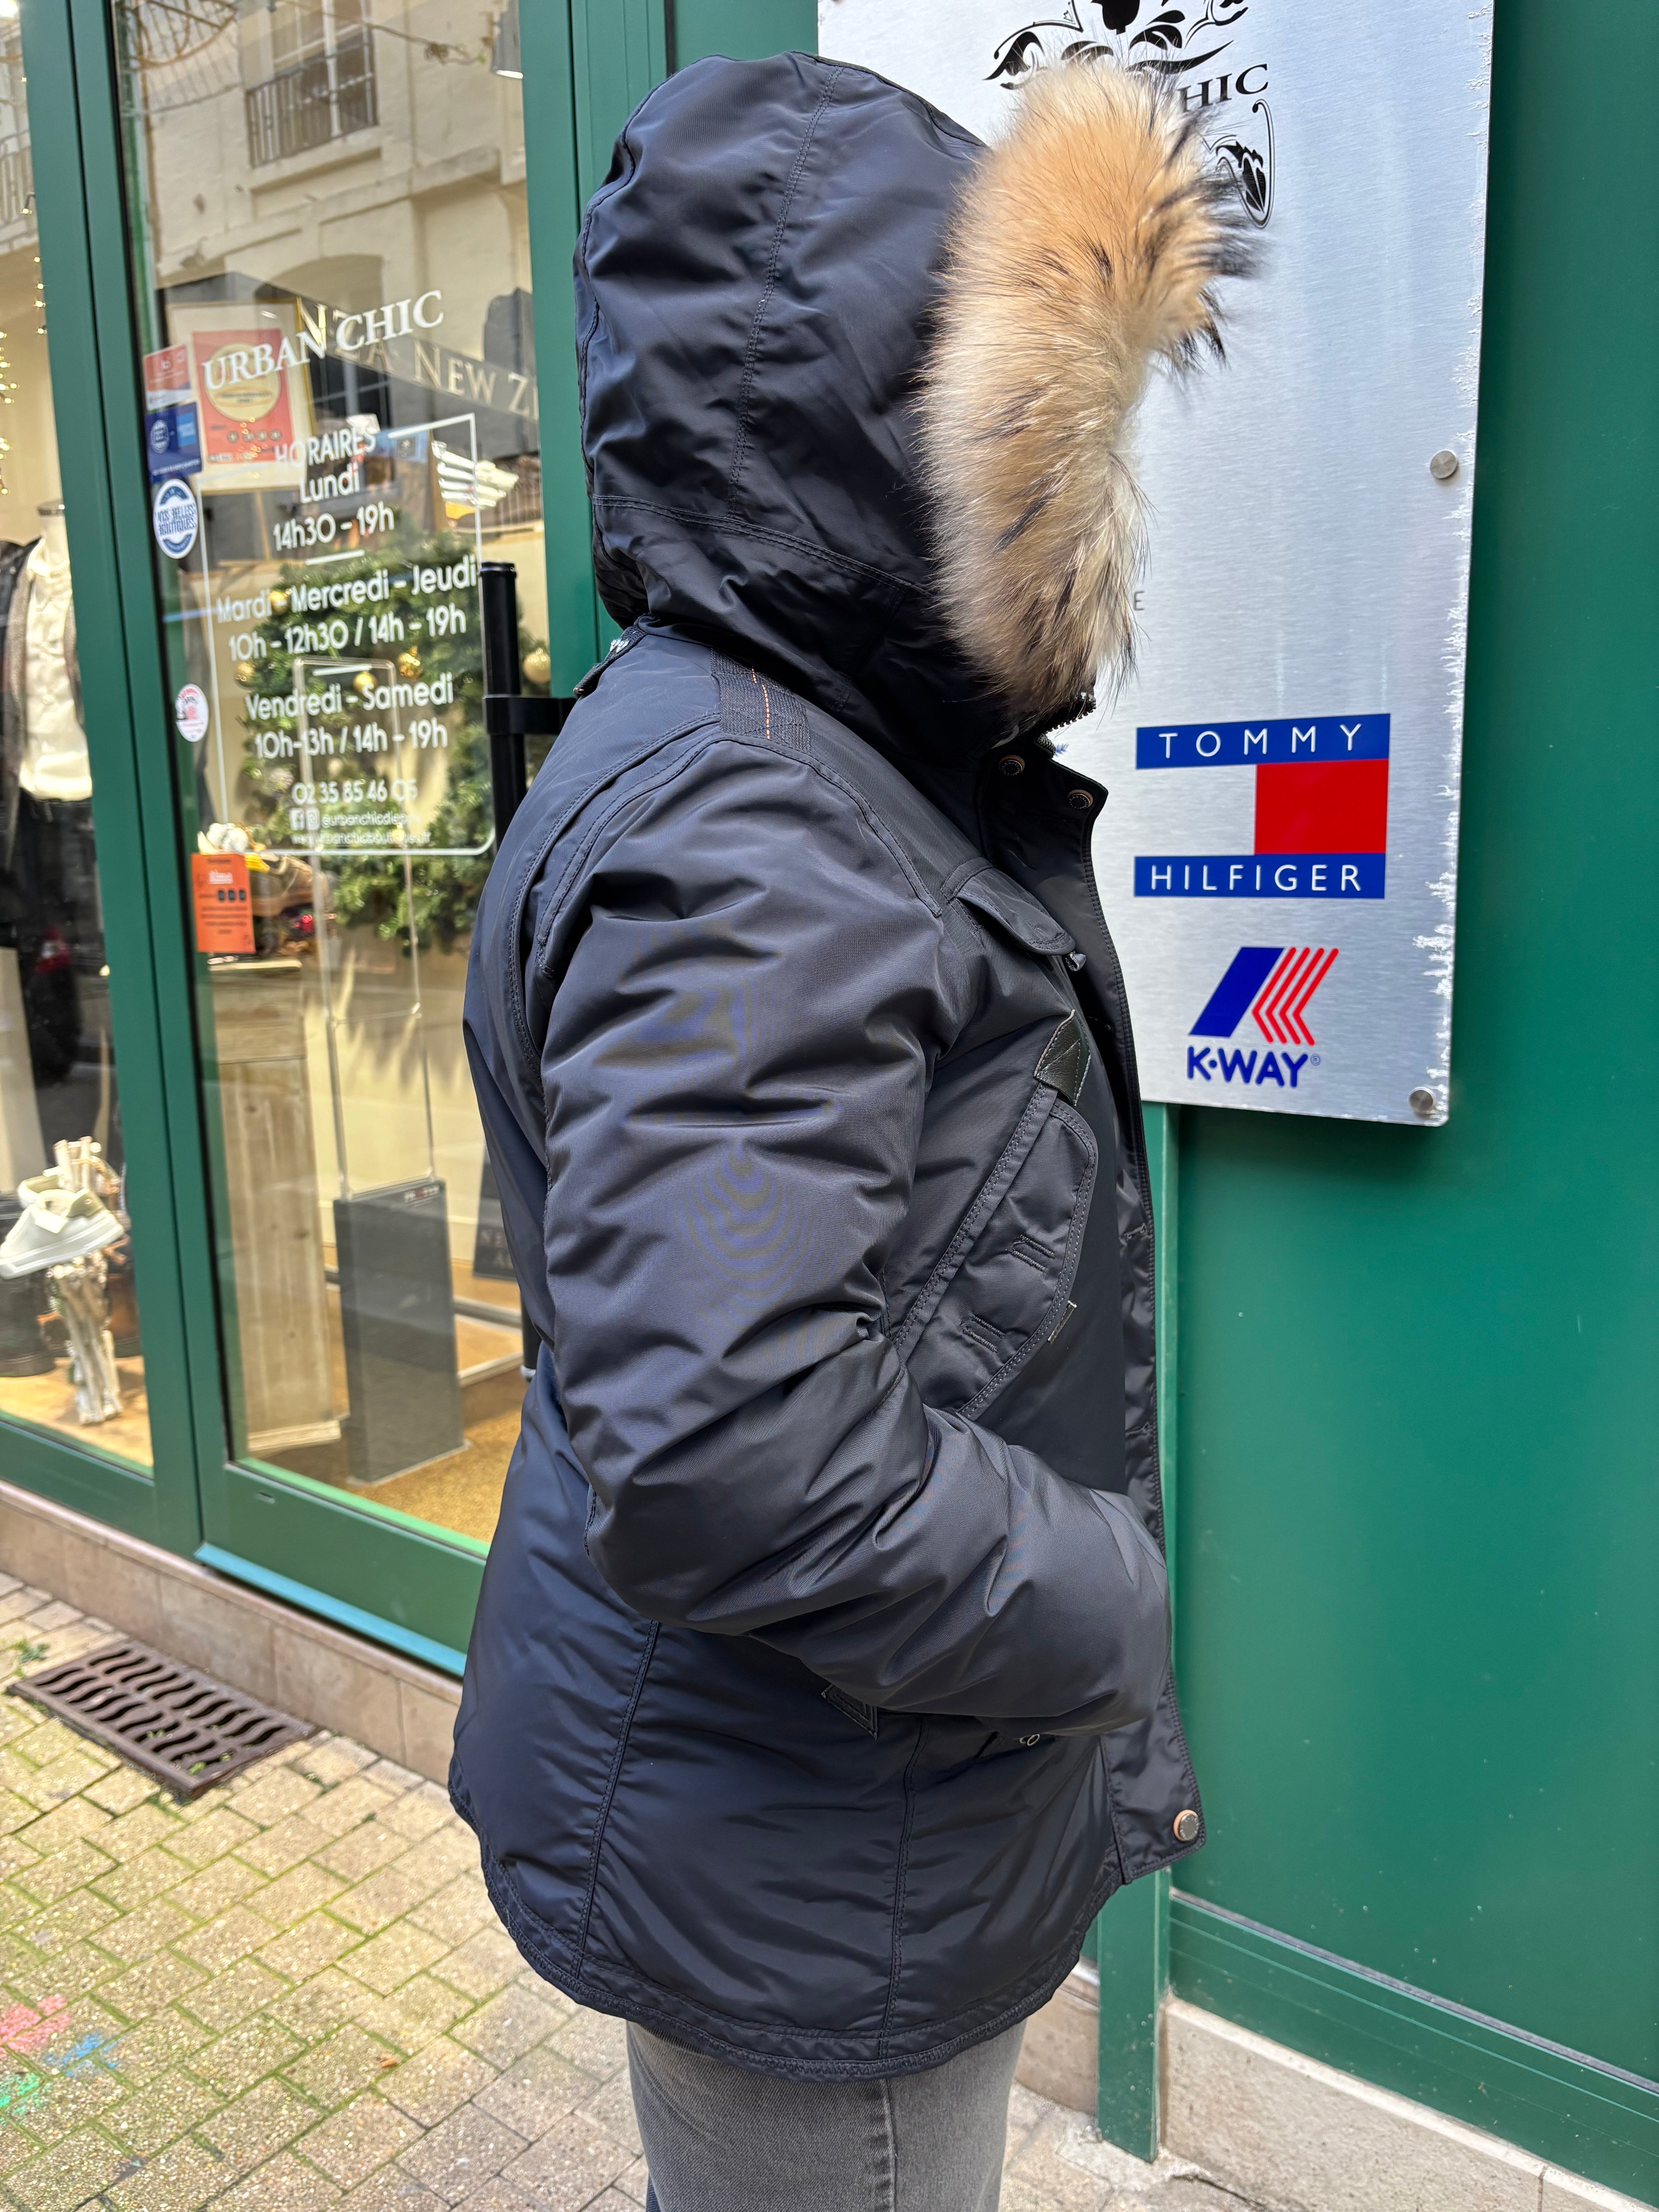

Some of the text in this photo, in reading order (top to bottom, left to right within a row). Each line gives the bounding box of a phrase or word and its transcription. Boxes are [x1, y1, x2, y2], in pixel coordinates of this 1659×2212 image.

[1178, 64, 1268, 112] HIC
[201, 290, 444, 390] URBAN CHIC
[274, 428, 376, 468] HORAIRES
[299, 462, 360, 503] Lundi
[273, 513, 336, 551] 14h30
[357, 501, 395, 535] 19h
[216, 587, 271, 623] Mardi
[291, 568, 390, 613] Mercredi
[411, 554, 477, 595] Jeudi
[229, 631, 267, 661] 10h
[284, 620, 349, 654] 12h30
[368, 611, 404, 644] 14h
[426, 602, 467, 638] 19h
[246, 683, 342, 720] Vendredi
[362, 672, 454, 710] Samedi
[352, 722, 388, 753] 14h
[409, 717, 448, 749] 19h
[1159, 723, 1362, 759] TOMMY
[292, 782, 316, 805] 02
[319, 781, 339, 804] 35
[367, 779, 387, 802] 46
[1151, 864, 1362, 891] HILFIGER
